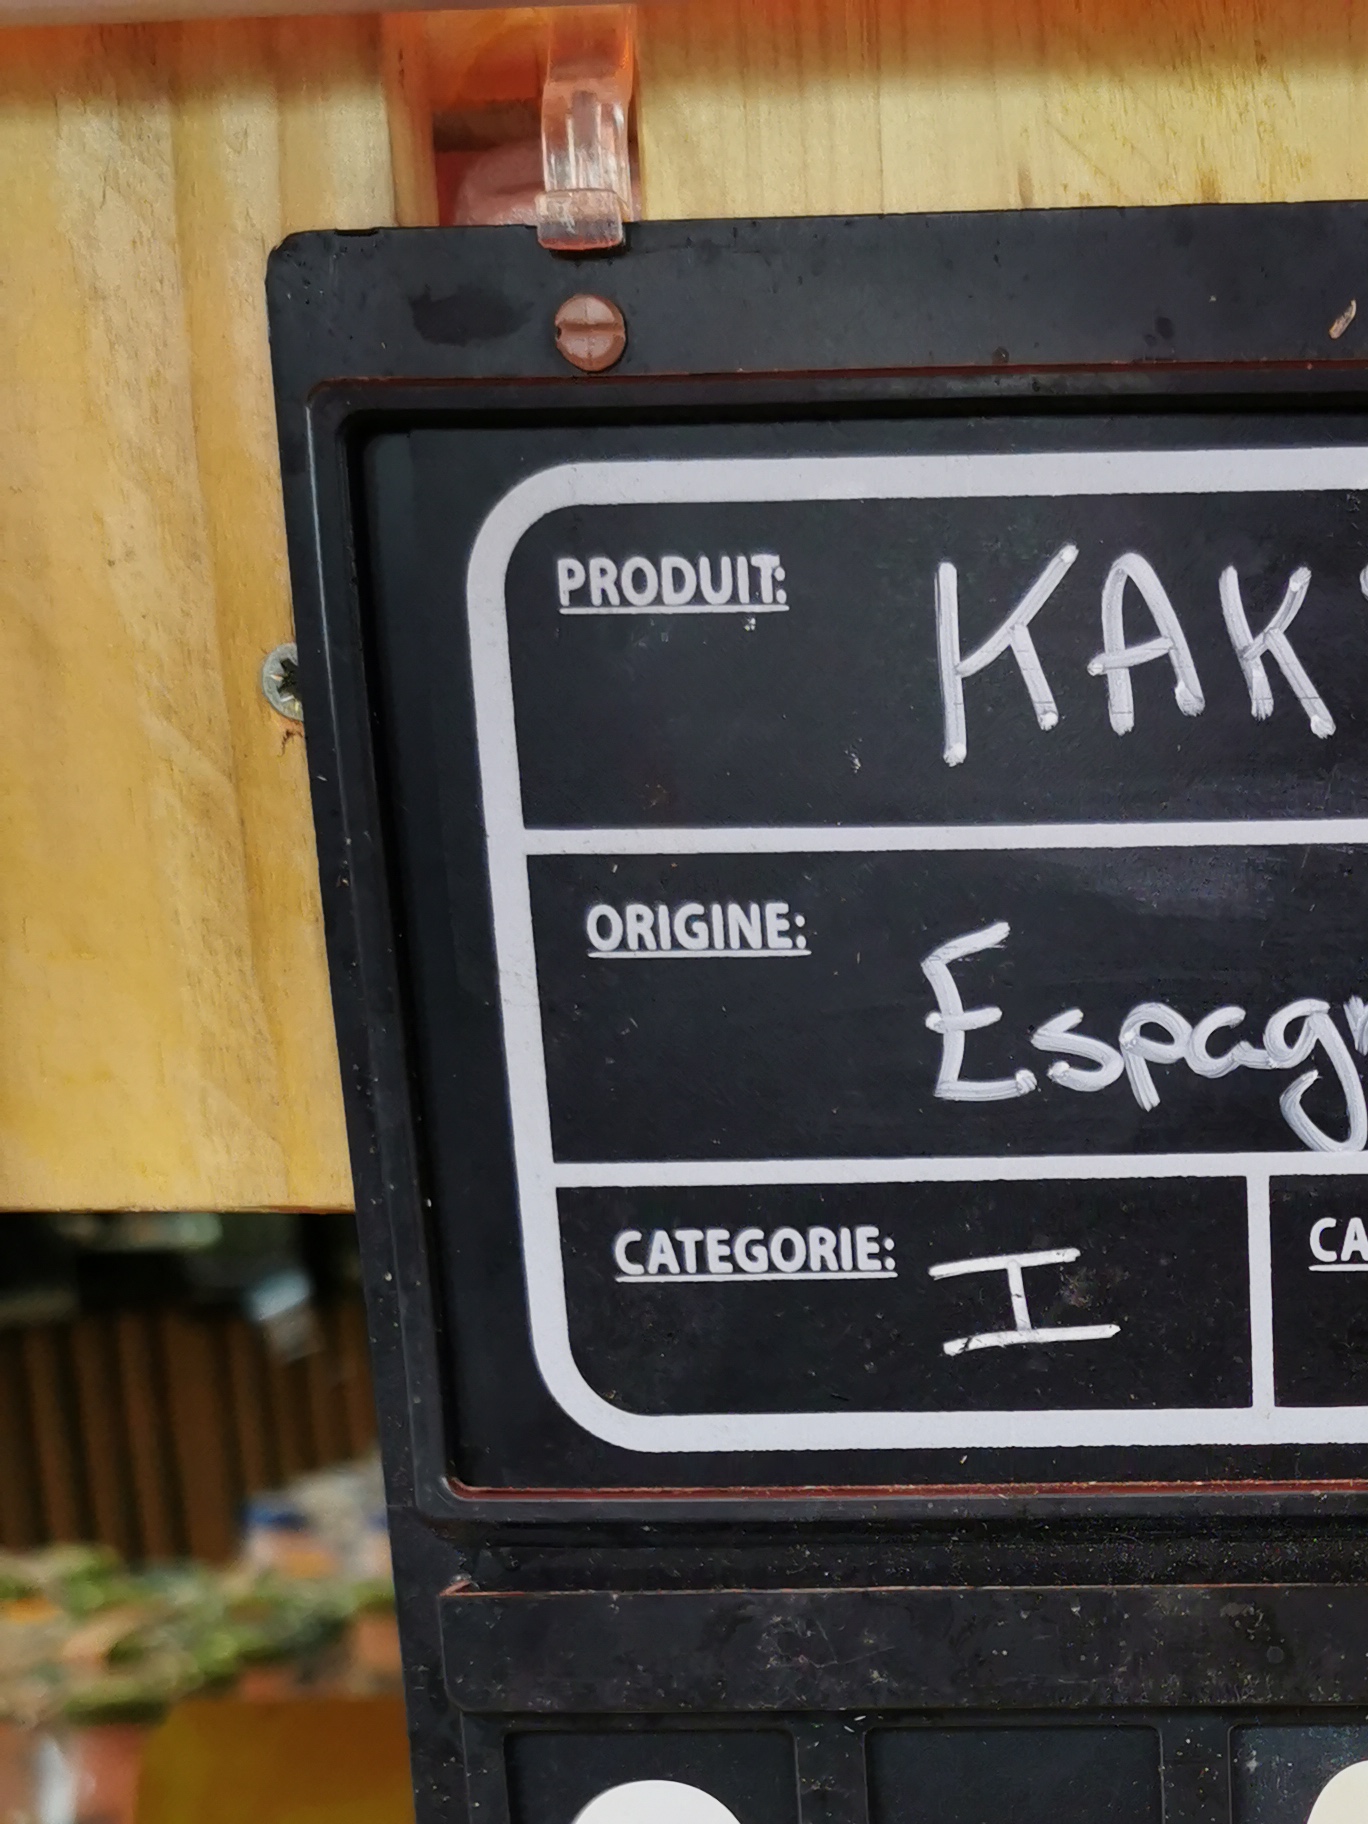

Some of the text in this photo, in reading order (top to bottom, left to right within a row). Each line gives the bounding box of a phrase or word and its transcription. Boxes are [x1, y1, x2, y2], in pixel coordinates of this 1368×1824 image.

[557, 554, 786, 606] PRODUIT:
[586, 901, 807, 951] ORIGINE:
[614, 1225, 1122, 1358] CATEGORIE: I
